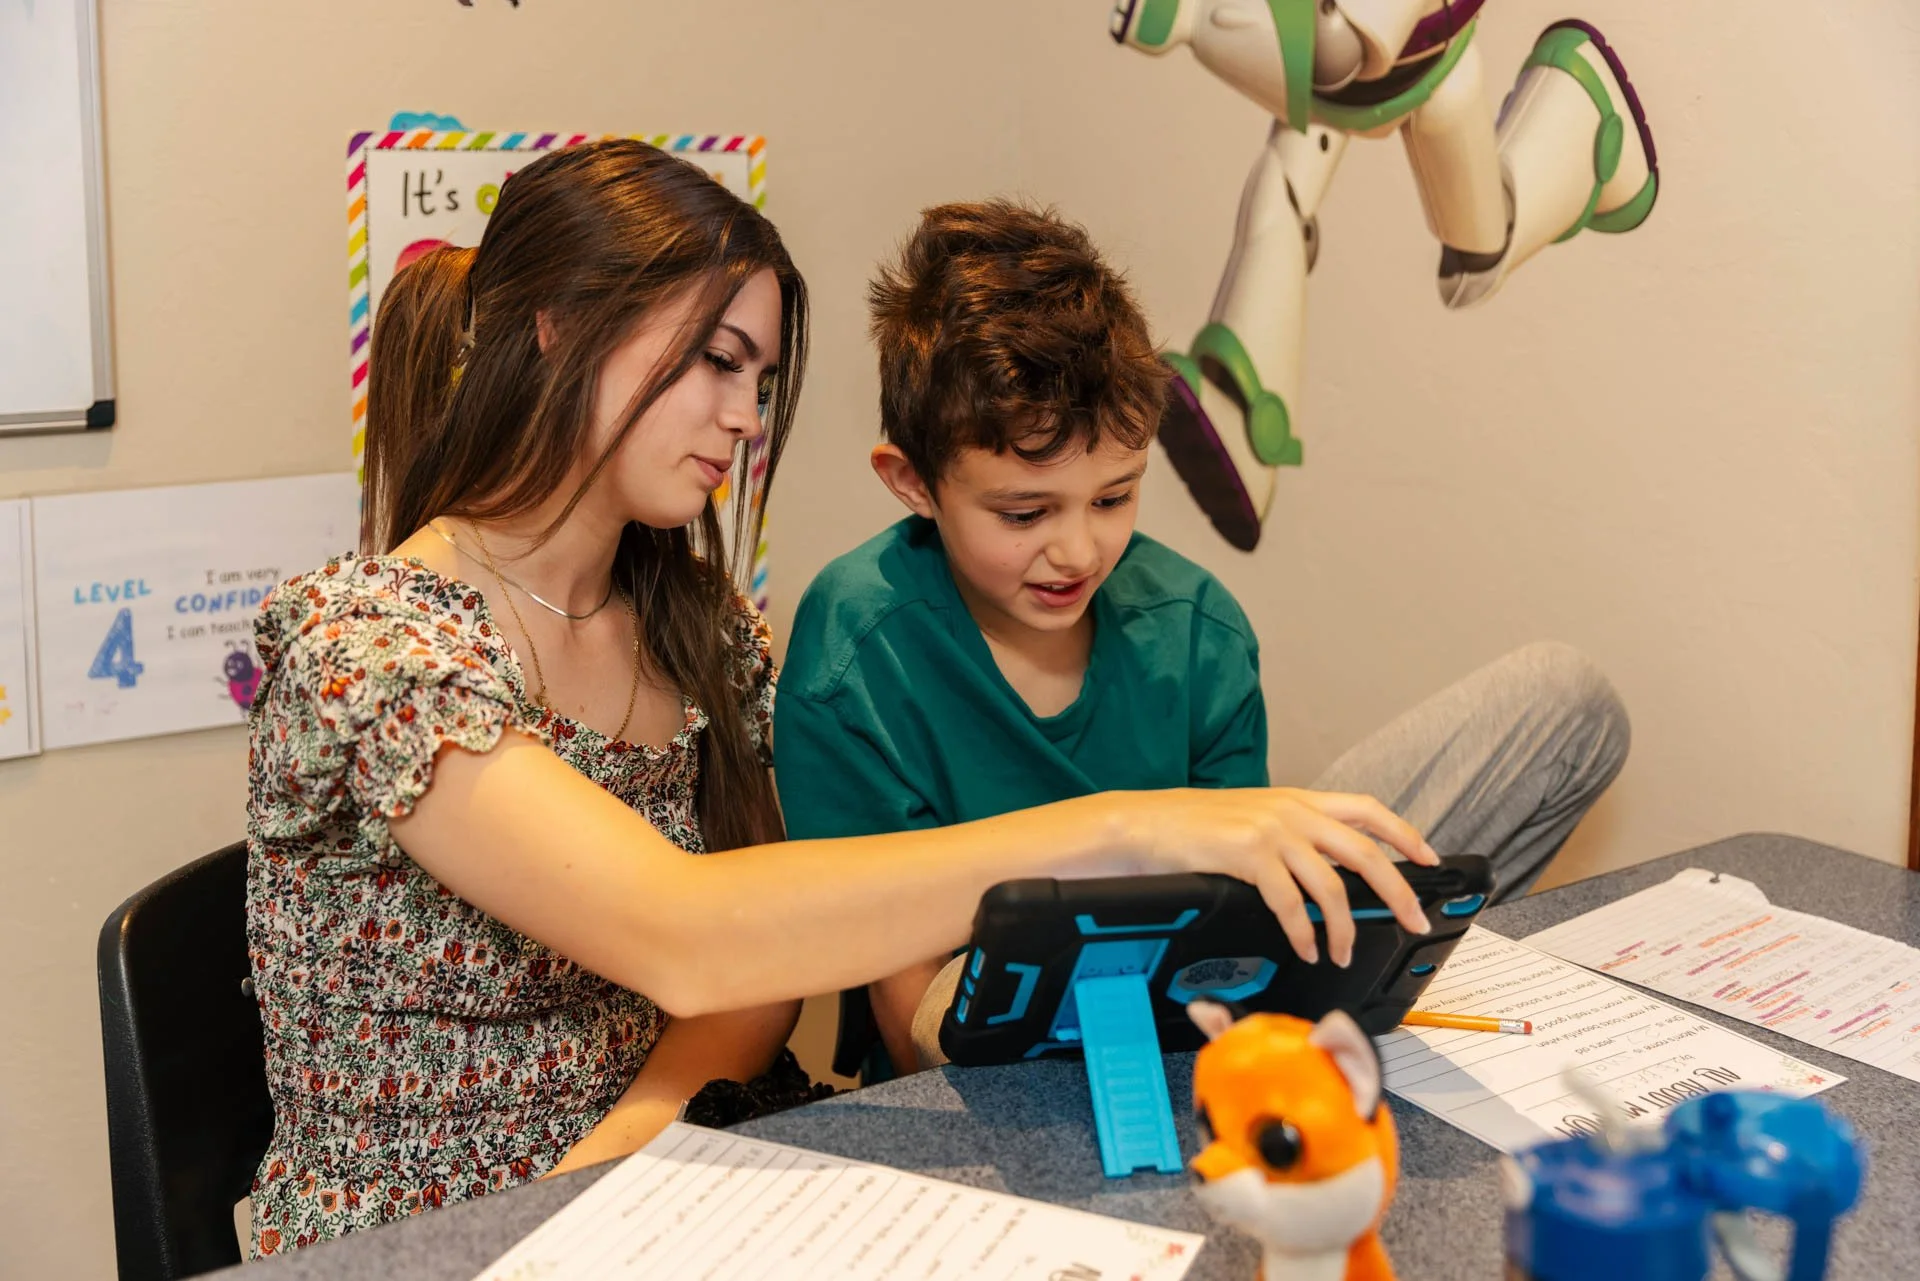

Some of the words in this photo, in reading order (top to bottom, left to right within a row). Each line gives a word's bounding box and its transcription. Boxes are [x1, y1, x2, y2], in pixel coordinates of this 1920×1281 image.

[402, 169, 459, 217] It's
[219, 570, 242, 584] am
[246, 567, 280, 584] very
[74, 579, 152, 604] LEVEL
[180, 623, 205, 639] can
[87, 607, 144, 689] 4
[1692, 1066, 1742, 1086] ALL
[1638, 1078, 1711, 1109] ABOUT
